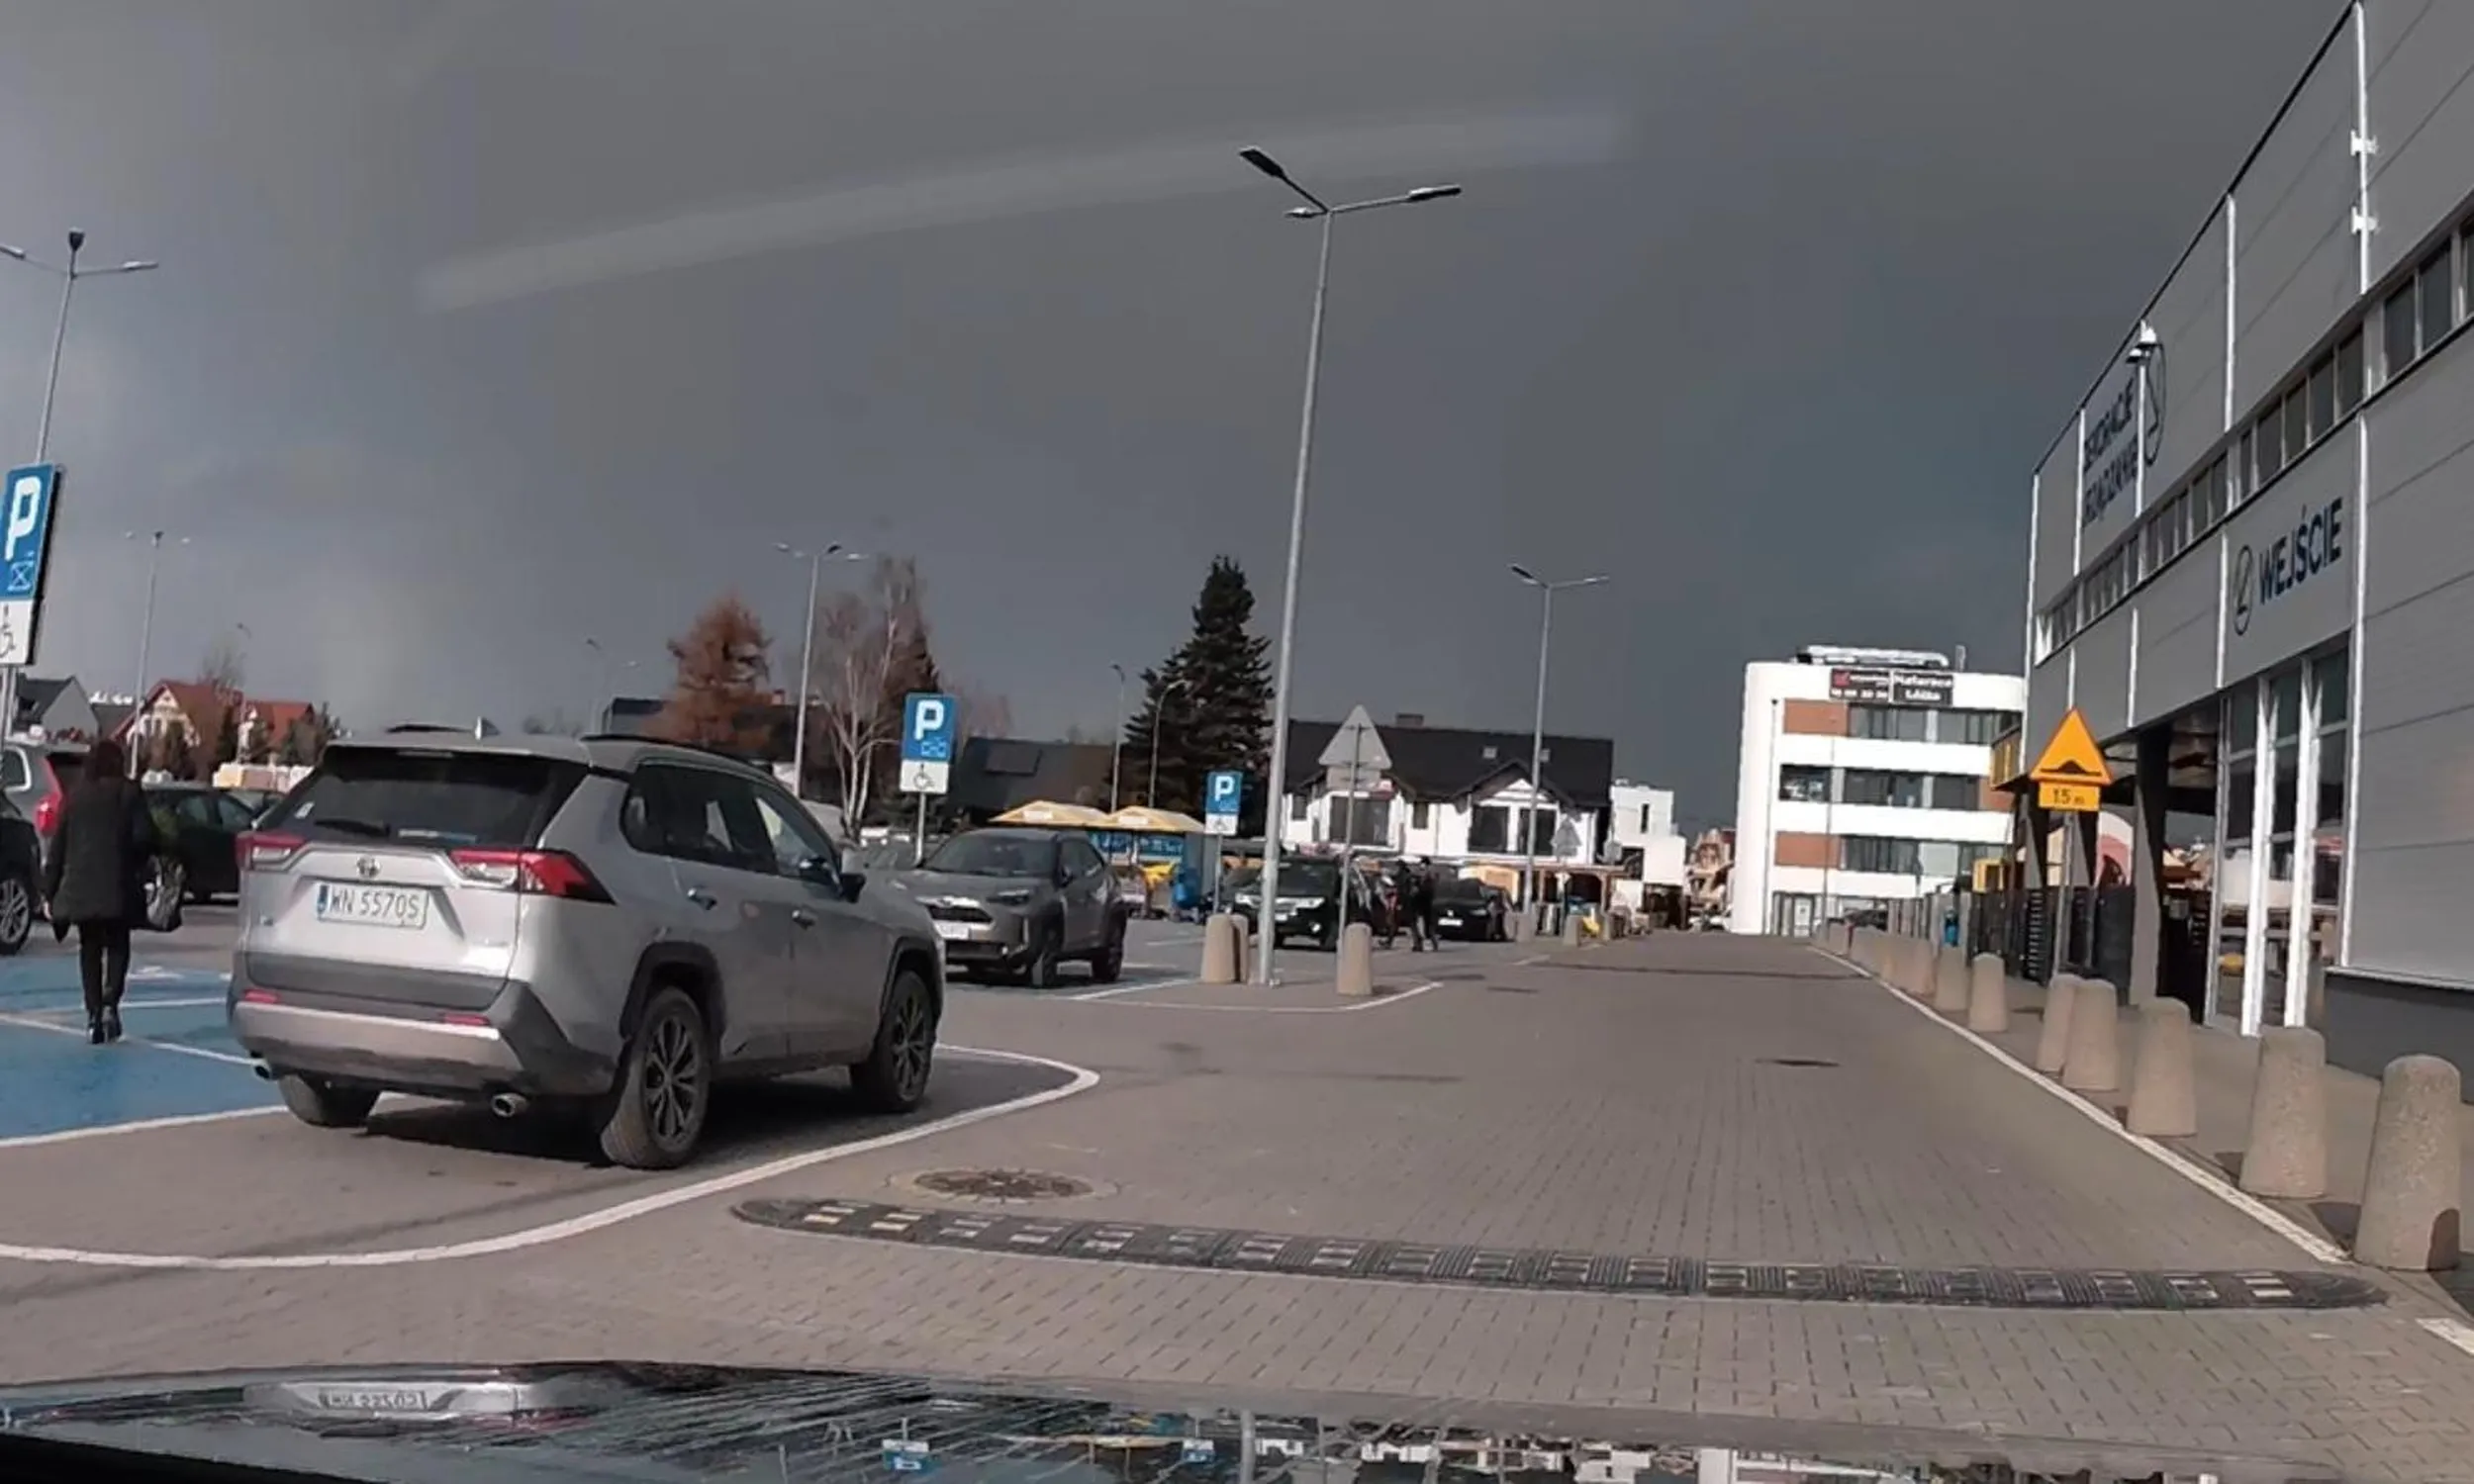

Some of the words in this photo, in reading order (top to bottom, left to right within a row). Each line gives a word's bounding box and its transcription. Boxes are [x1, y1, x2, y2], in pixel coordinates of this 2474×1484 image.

[5, 476, 42, 561] P
[2258, 497, 2343, 605] WEJŚCIE
[914, 699, 944, 740] P
[1215, 776, 1234, 801] P
[330, 888, 355, 913] WN
